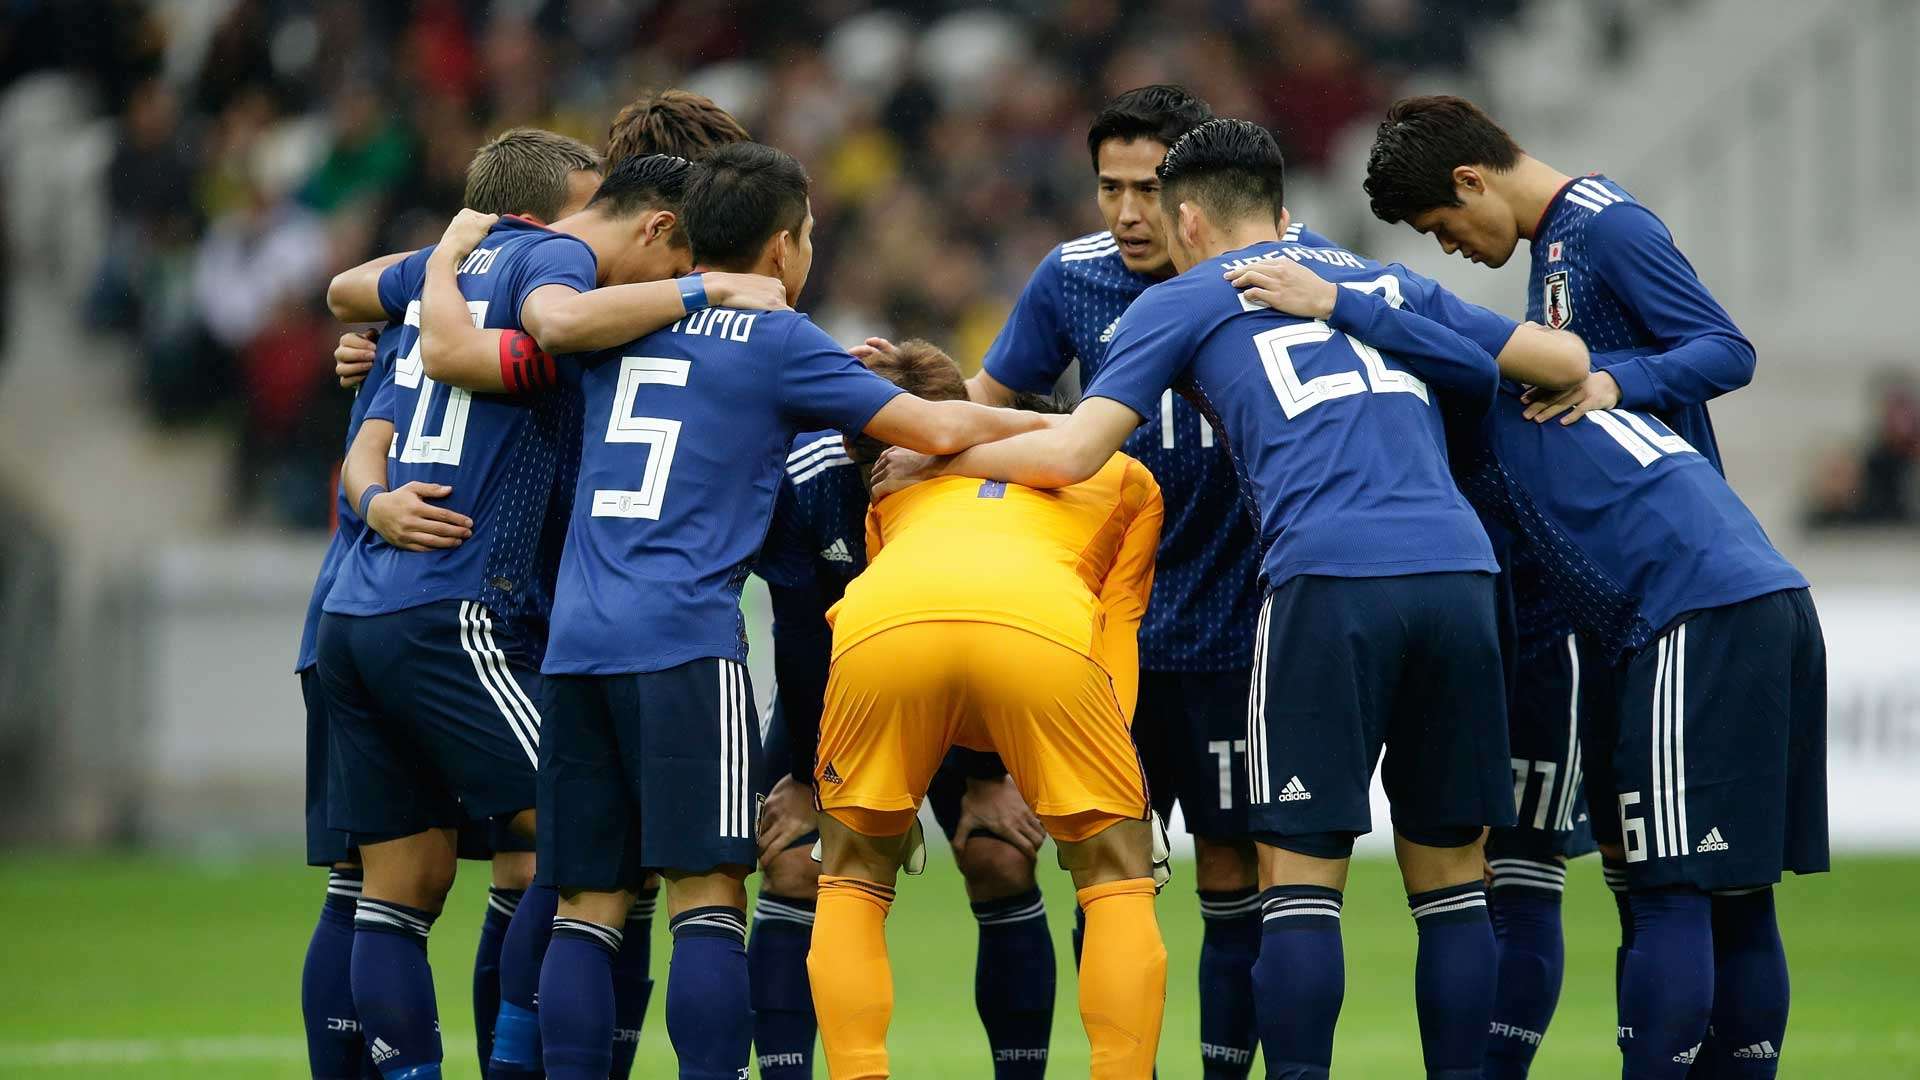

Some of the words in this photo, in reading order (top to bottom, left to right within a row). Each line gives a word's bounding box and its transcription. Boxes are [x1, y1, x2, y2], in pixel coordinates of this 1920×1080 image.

[591, 356, 692, 521] 5
[1278, 791, 1312, 802] adidas
[1696, 842, 1729, 853] adidas
[1488, 1021, 1542, 1047] JAPAN
[757, 1052, 804, 1068] APAN
[994, 1048, 1048, 1061] JAPAN
[1200, 1041, 1249, 1064] APAN
